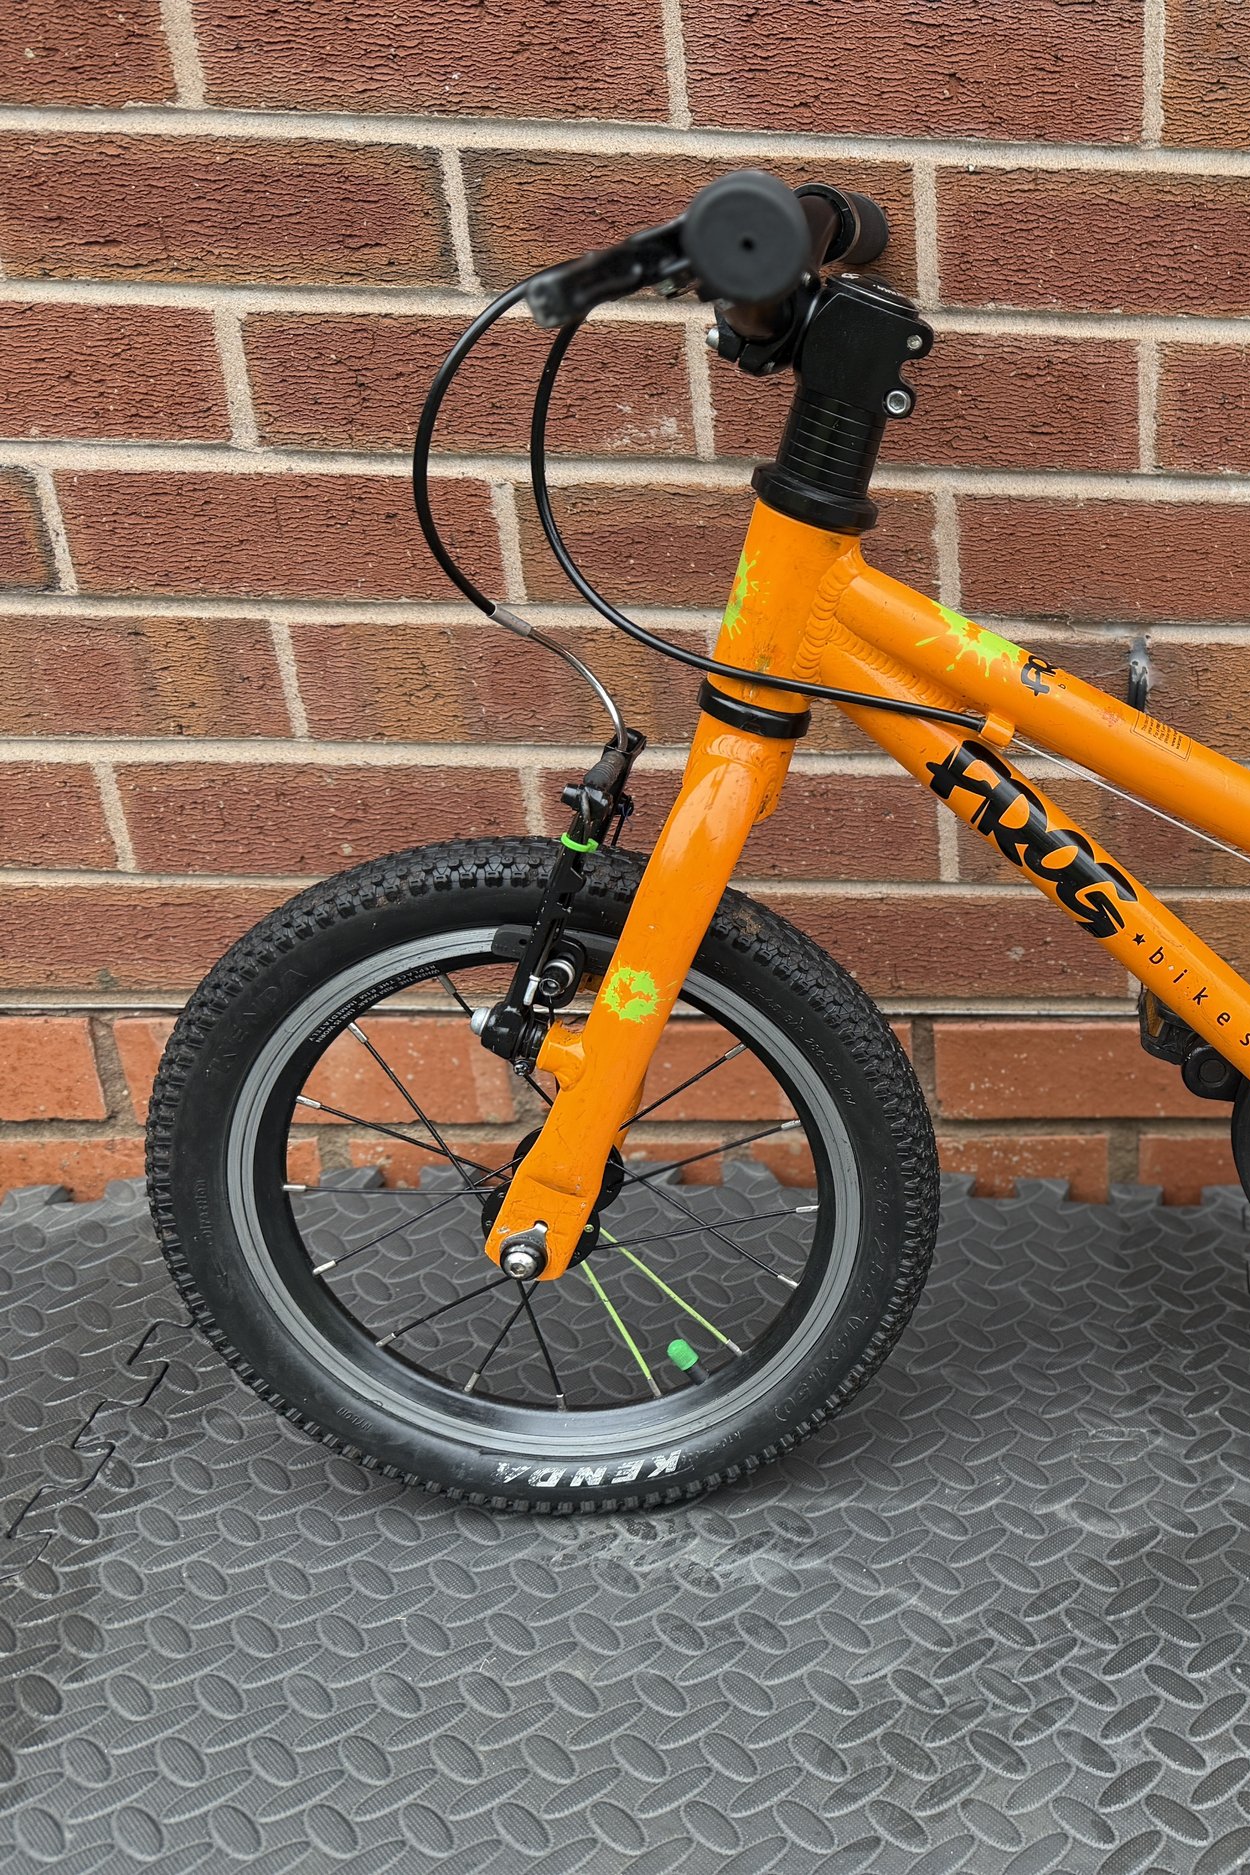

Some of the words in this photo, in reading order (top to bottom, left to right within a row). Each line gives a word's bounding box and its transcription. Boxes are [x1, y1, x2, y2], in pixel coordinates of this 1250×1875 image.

[925, 739, 1140, 939] FROG
[396, 963, 437, 981] REPLACE
[414, 968, 441, 980] WHEN
[379, 980, 394, 990] THE
[400, 977, 413, 986] THE
[359, 989, 377, 1001] RIM
[308, 999, 358, 1042] IMMEDIATELY
[341, 1008, 356, 1021] LINE
[315, 1023, 336, 1043] WORN
[337, 1407, 373, 1432] NYLON
[490, 1449, 682, 1488] KENDA
